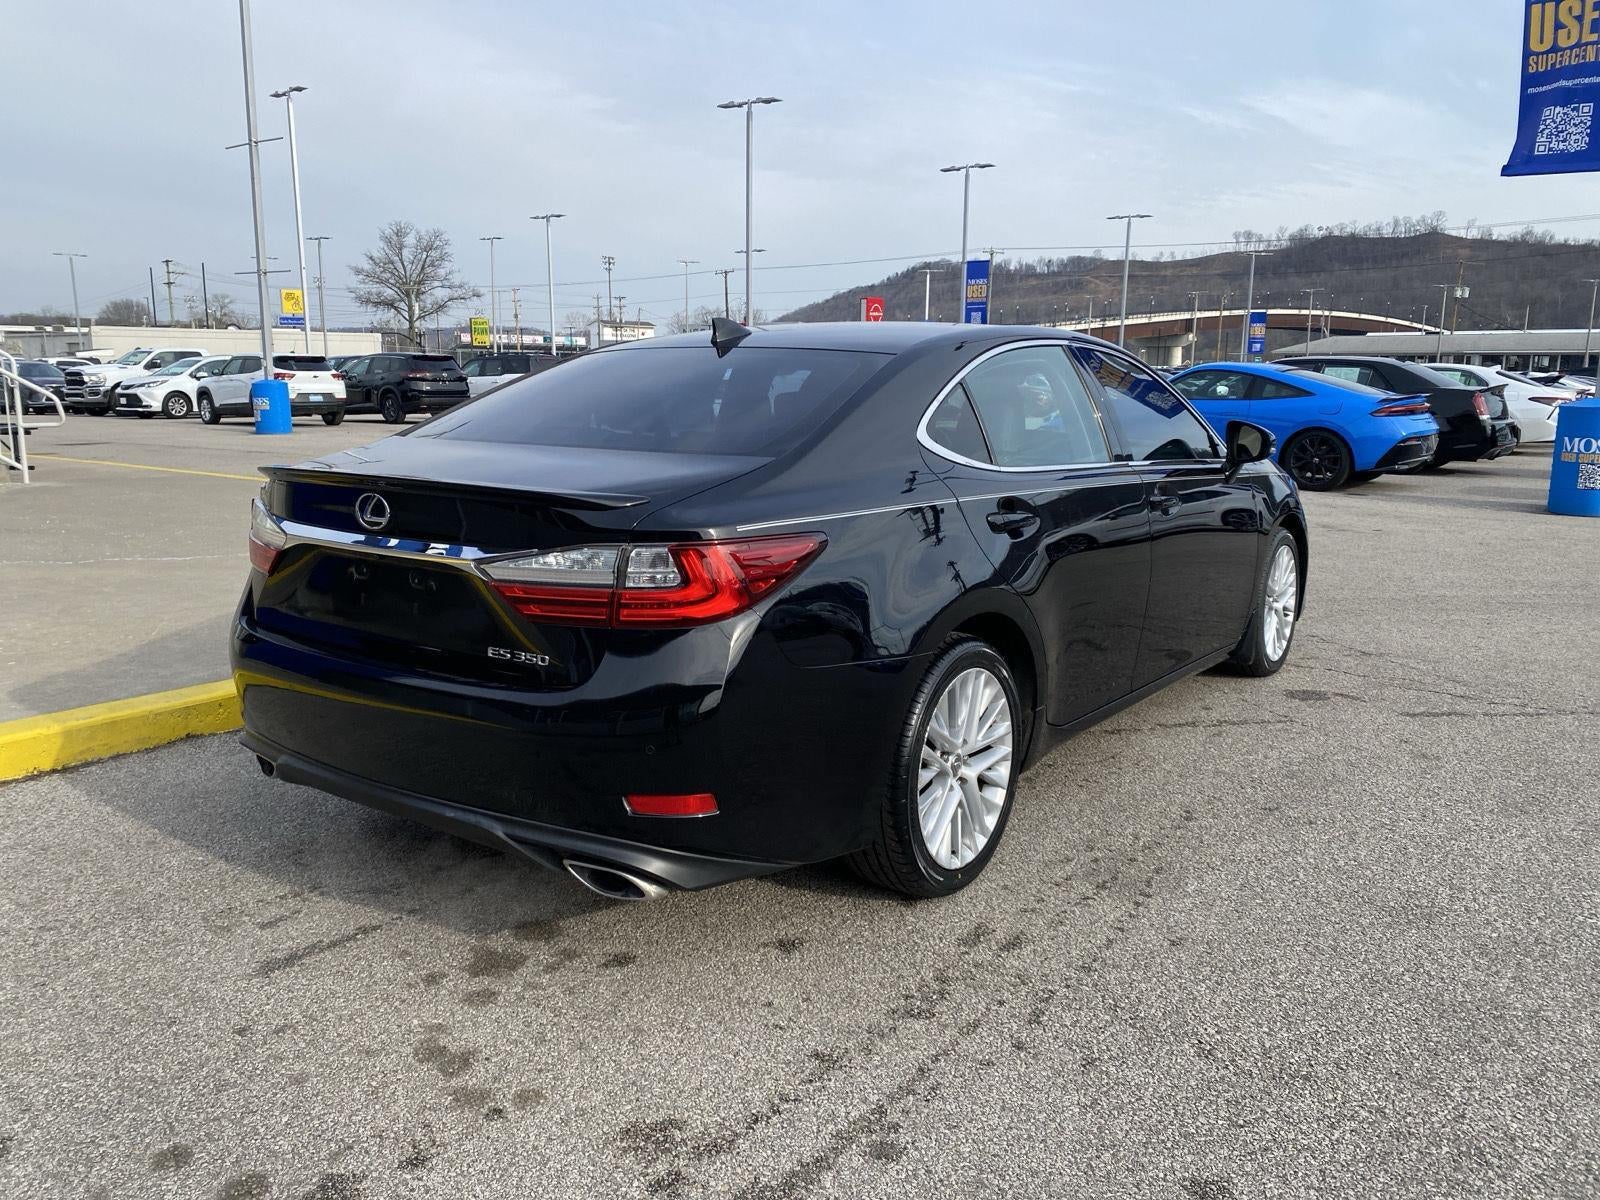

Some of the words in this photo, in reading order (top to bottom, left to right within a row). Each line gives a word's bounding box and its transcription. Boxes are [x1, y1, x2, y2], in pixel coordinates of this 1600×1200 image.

[967, 284, 987, 298] USED
[487, 646, 511, 660] ES
[513, 650, 550, 666] 350
